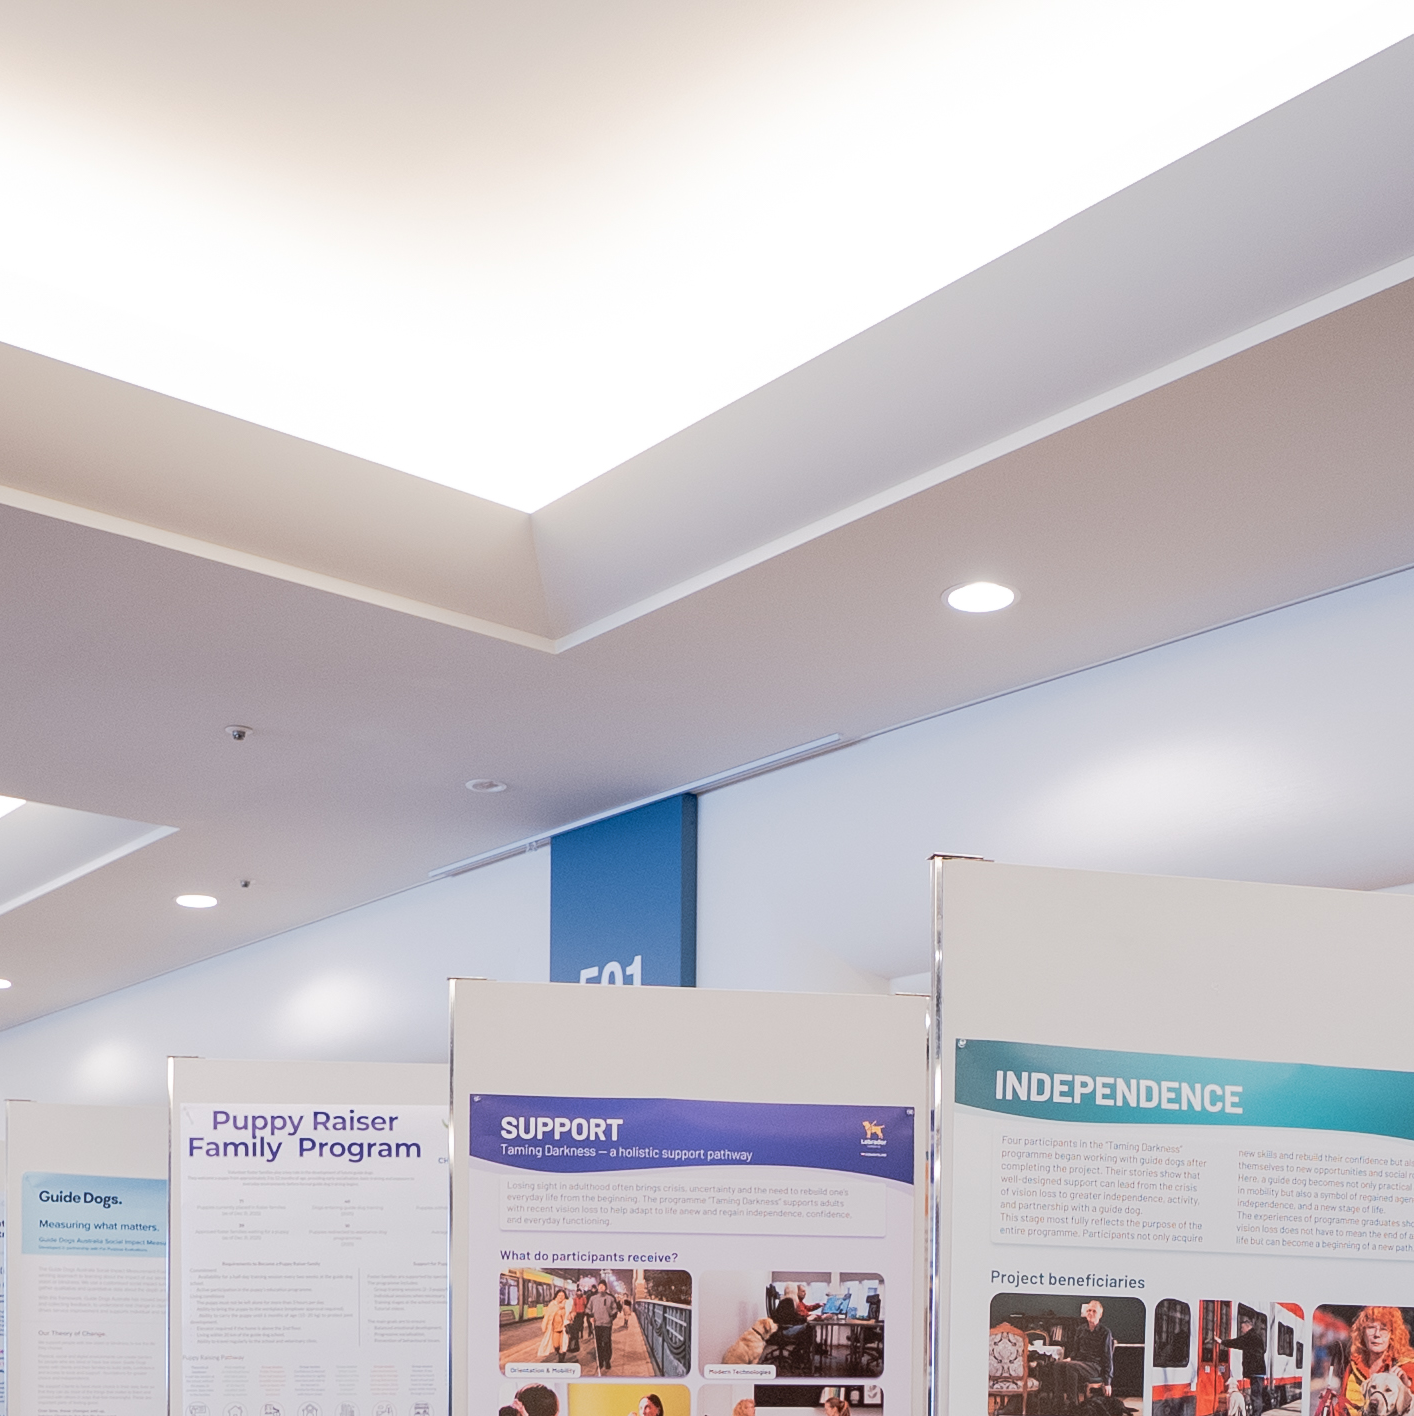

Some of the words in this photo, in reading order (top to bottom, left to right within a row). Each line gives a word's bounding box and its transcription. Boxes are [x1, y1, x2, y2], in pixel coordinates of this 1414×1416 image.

[995, 1070, 1244, 1115] INDEPENDENCE
[213, 1110, 304, 1137] Puppy
[313, 1109, 399, 1131] Raiser
[500, 1116, 624, 1142] SUPPORT
[189, 1137, 283, 1163] Family
[299, 1137, 421, 1163] Program
[500, 1143, 543, 1158] Taming
[545, 1144, 596, 1157] Darkness
[609, 1148, 617, 1157] a
[619, 1146, 660, 1158] holistic
[662, 1149, 705, 1161] support
[707, 1149, 753, 1163] pathway
[39, 1190, 81, 1203] Guide
[83, 1192, 122, 1208] Dogs.
[39, 1219, 91, 1232] Measuring
[93, 1222, 118, 1230] what
[120, 1223, 159, 1232] matters.
[500, 1250, 531, 1261] What
[534, 1250, 549, 1261] do
[552, 1251, 625, 1264] participants
[627, 1252, 678, 1263] receive?
[991, 1270, 1044, 1288] Project
[1048, 1272, 1145, 1289] beneficiaries
